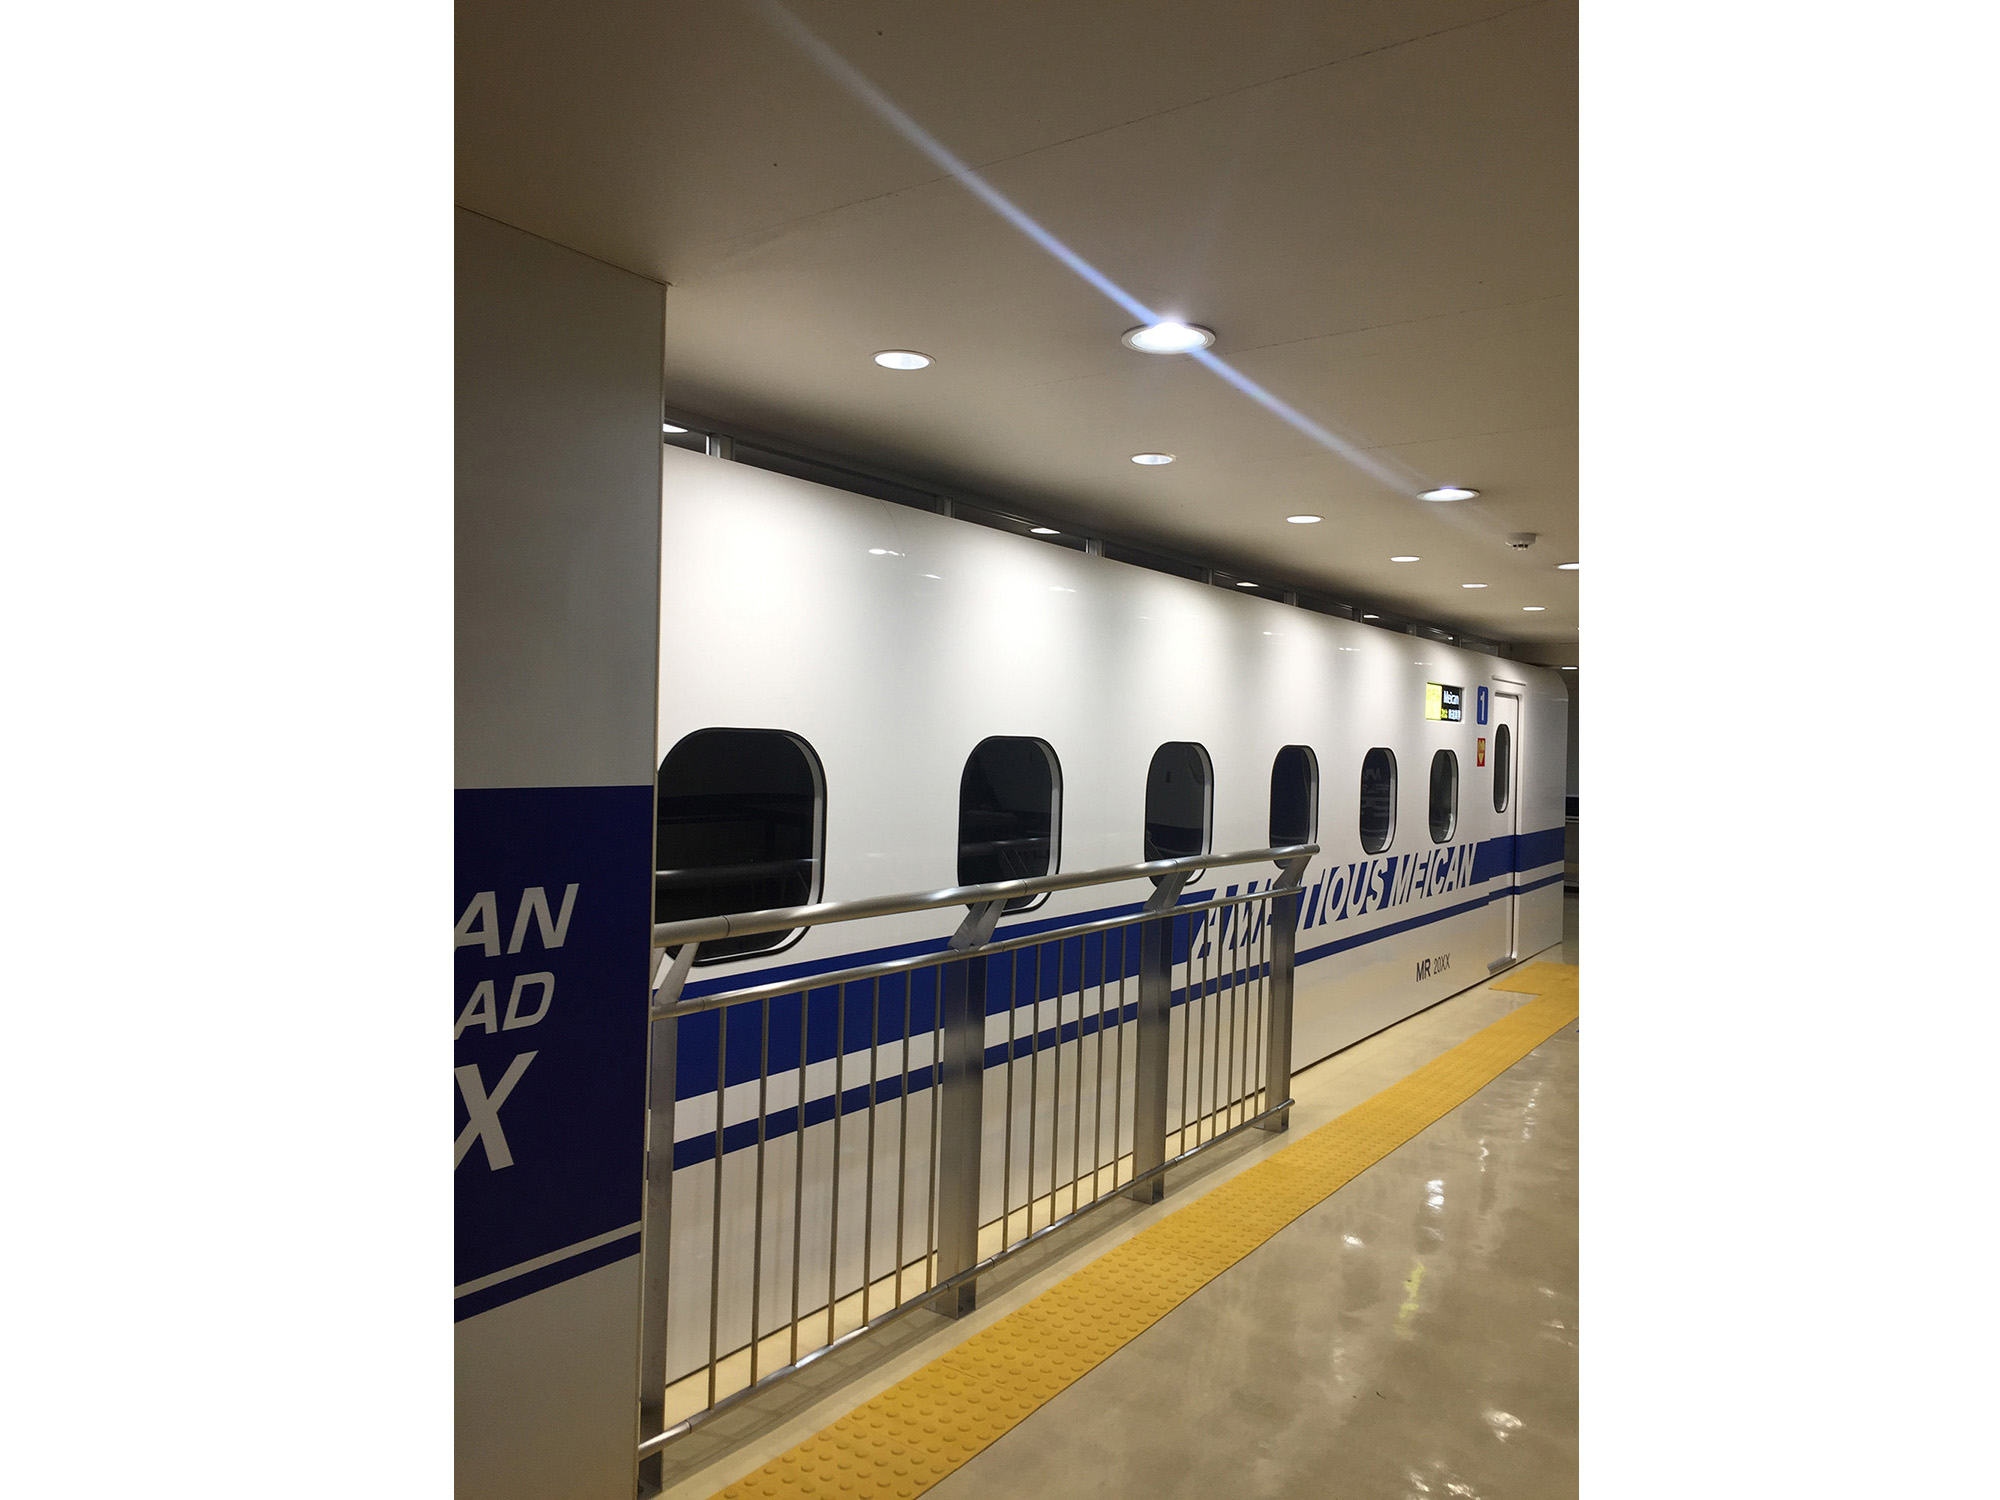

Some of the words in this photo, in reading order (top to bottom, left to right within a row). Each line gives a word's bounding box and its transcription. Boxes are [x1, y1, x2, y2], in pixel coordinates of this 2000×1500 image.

[1480, 691, 1485, 721] 1
[1190, 857, 1390, 961] AMTIOUS
[1388, 842, 1478, 908] MEICAN
[1416, 958, 1431, 982] MR
[1433, 953, 1450, 975] 20XX
[454, 1050, 539, 1171] X
